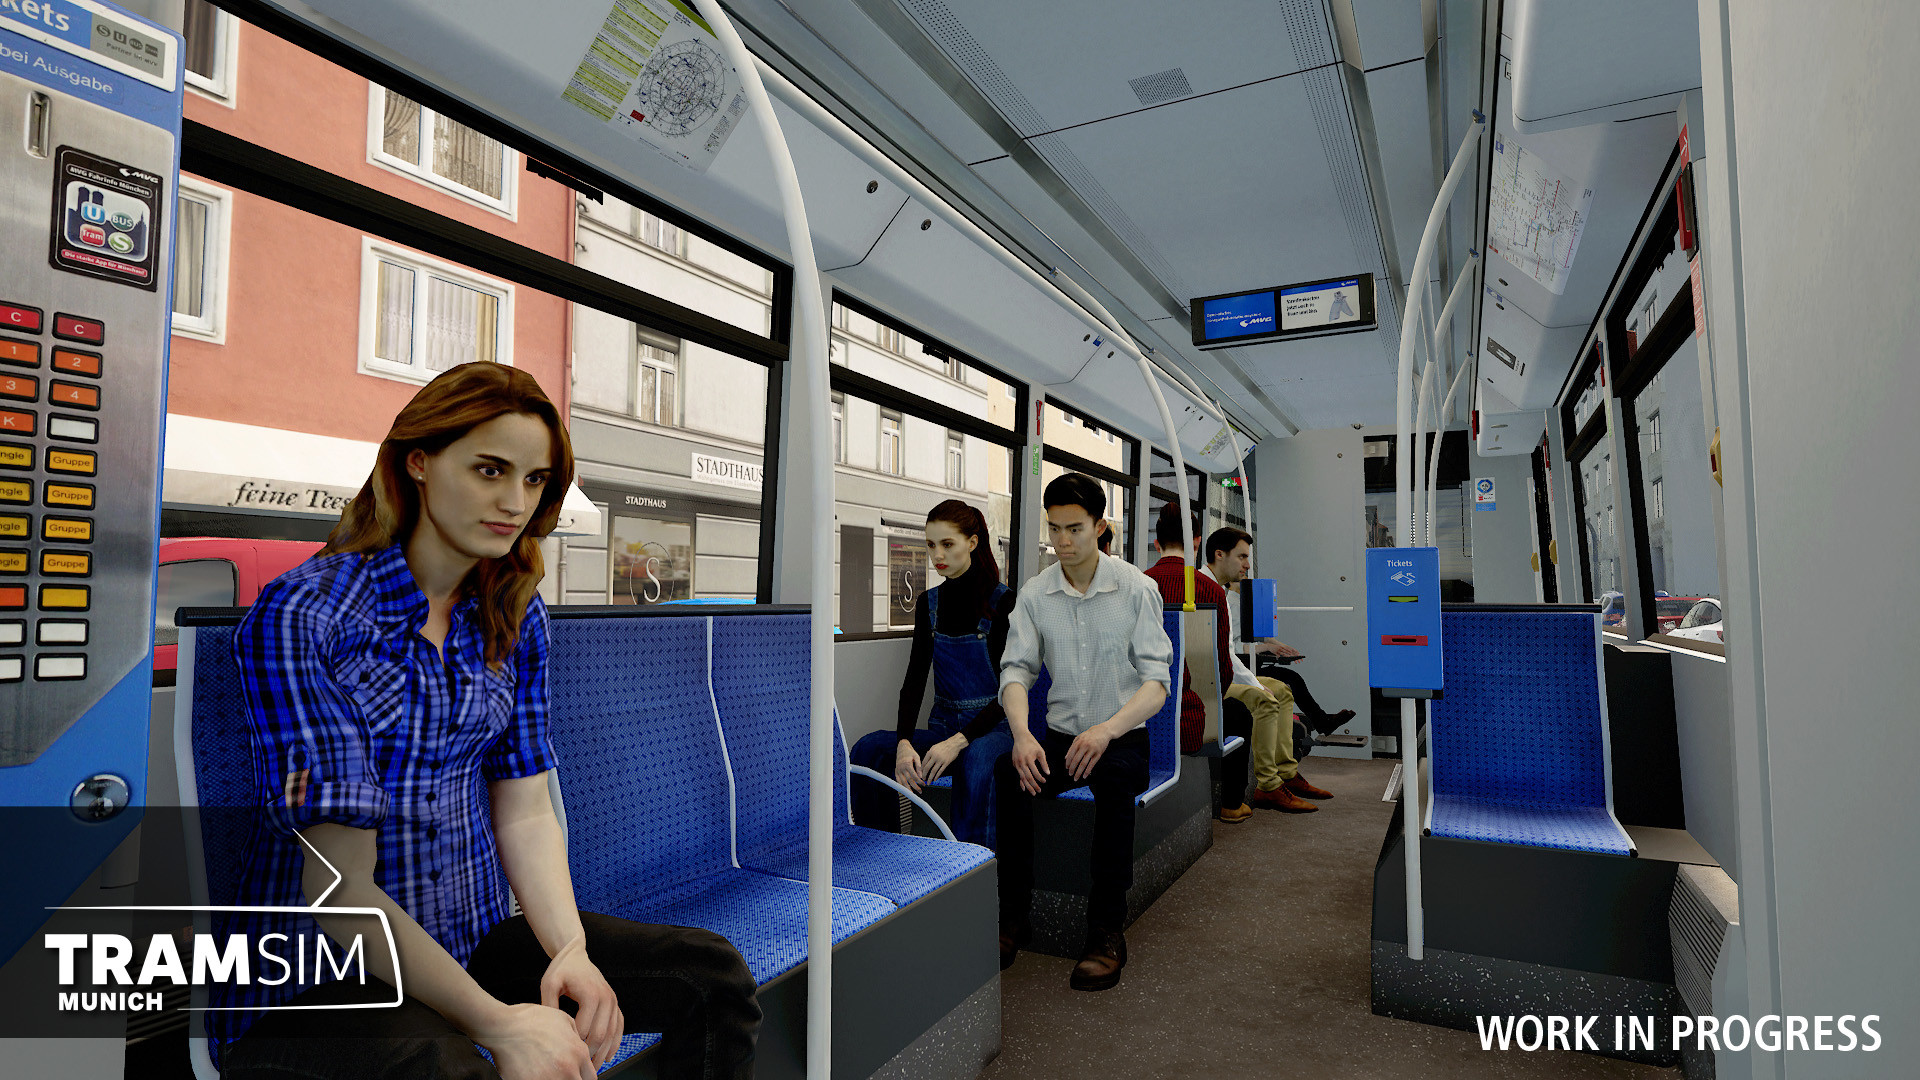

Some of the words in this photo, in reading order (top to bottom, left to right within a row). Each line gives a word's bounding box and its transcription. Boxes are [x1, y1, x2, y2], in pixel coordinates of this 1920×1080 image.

[106, 42, 132, 56] Partner
[33, 57, 113, 94] Ausgabe
[69, 166, 87, 177] MVG
[88, 171, 118, 186] Fahrinfo
[119, 181, 149, 196] München
[131, 171, 159, 184] MVG
[87, 204, 102, 220] U
[112, 215, 133, 228] BUS
[82, 229, 103, 240] Tram
[114, 234, 130, 251] S
[95, 257, 107, 266] App
[108, 260, 117, 268] für
[11, 312, 21, 322] C
[74, 324, 84, 334] C
[1250, 316, 1272, 325] MVG
[11, 346, 16, 355] 1
[72, 357, 81, 367] 2
[6, 380, 16, 391] 3
[70, 391, 79, 400] 4
[3, 416, 15, 427] K
[52, 456, 91, 467] Gruppe
[696, 456, 764, 484] STADTHAUS
[51, 490, 89, 501] Gruppe
[227, 481, 298, 507] feine
[625, 495, 667, 509] STADTHAUS
[49, 523, 87, 534] Gruppe
[47, 559, 85, 569] Gruppe
[1386, 559, 1413, 568] Tickets
[643, 556, 661, 603] S
[904, 570, 913, 603] S
